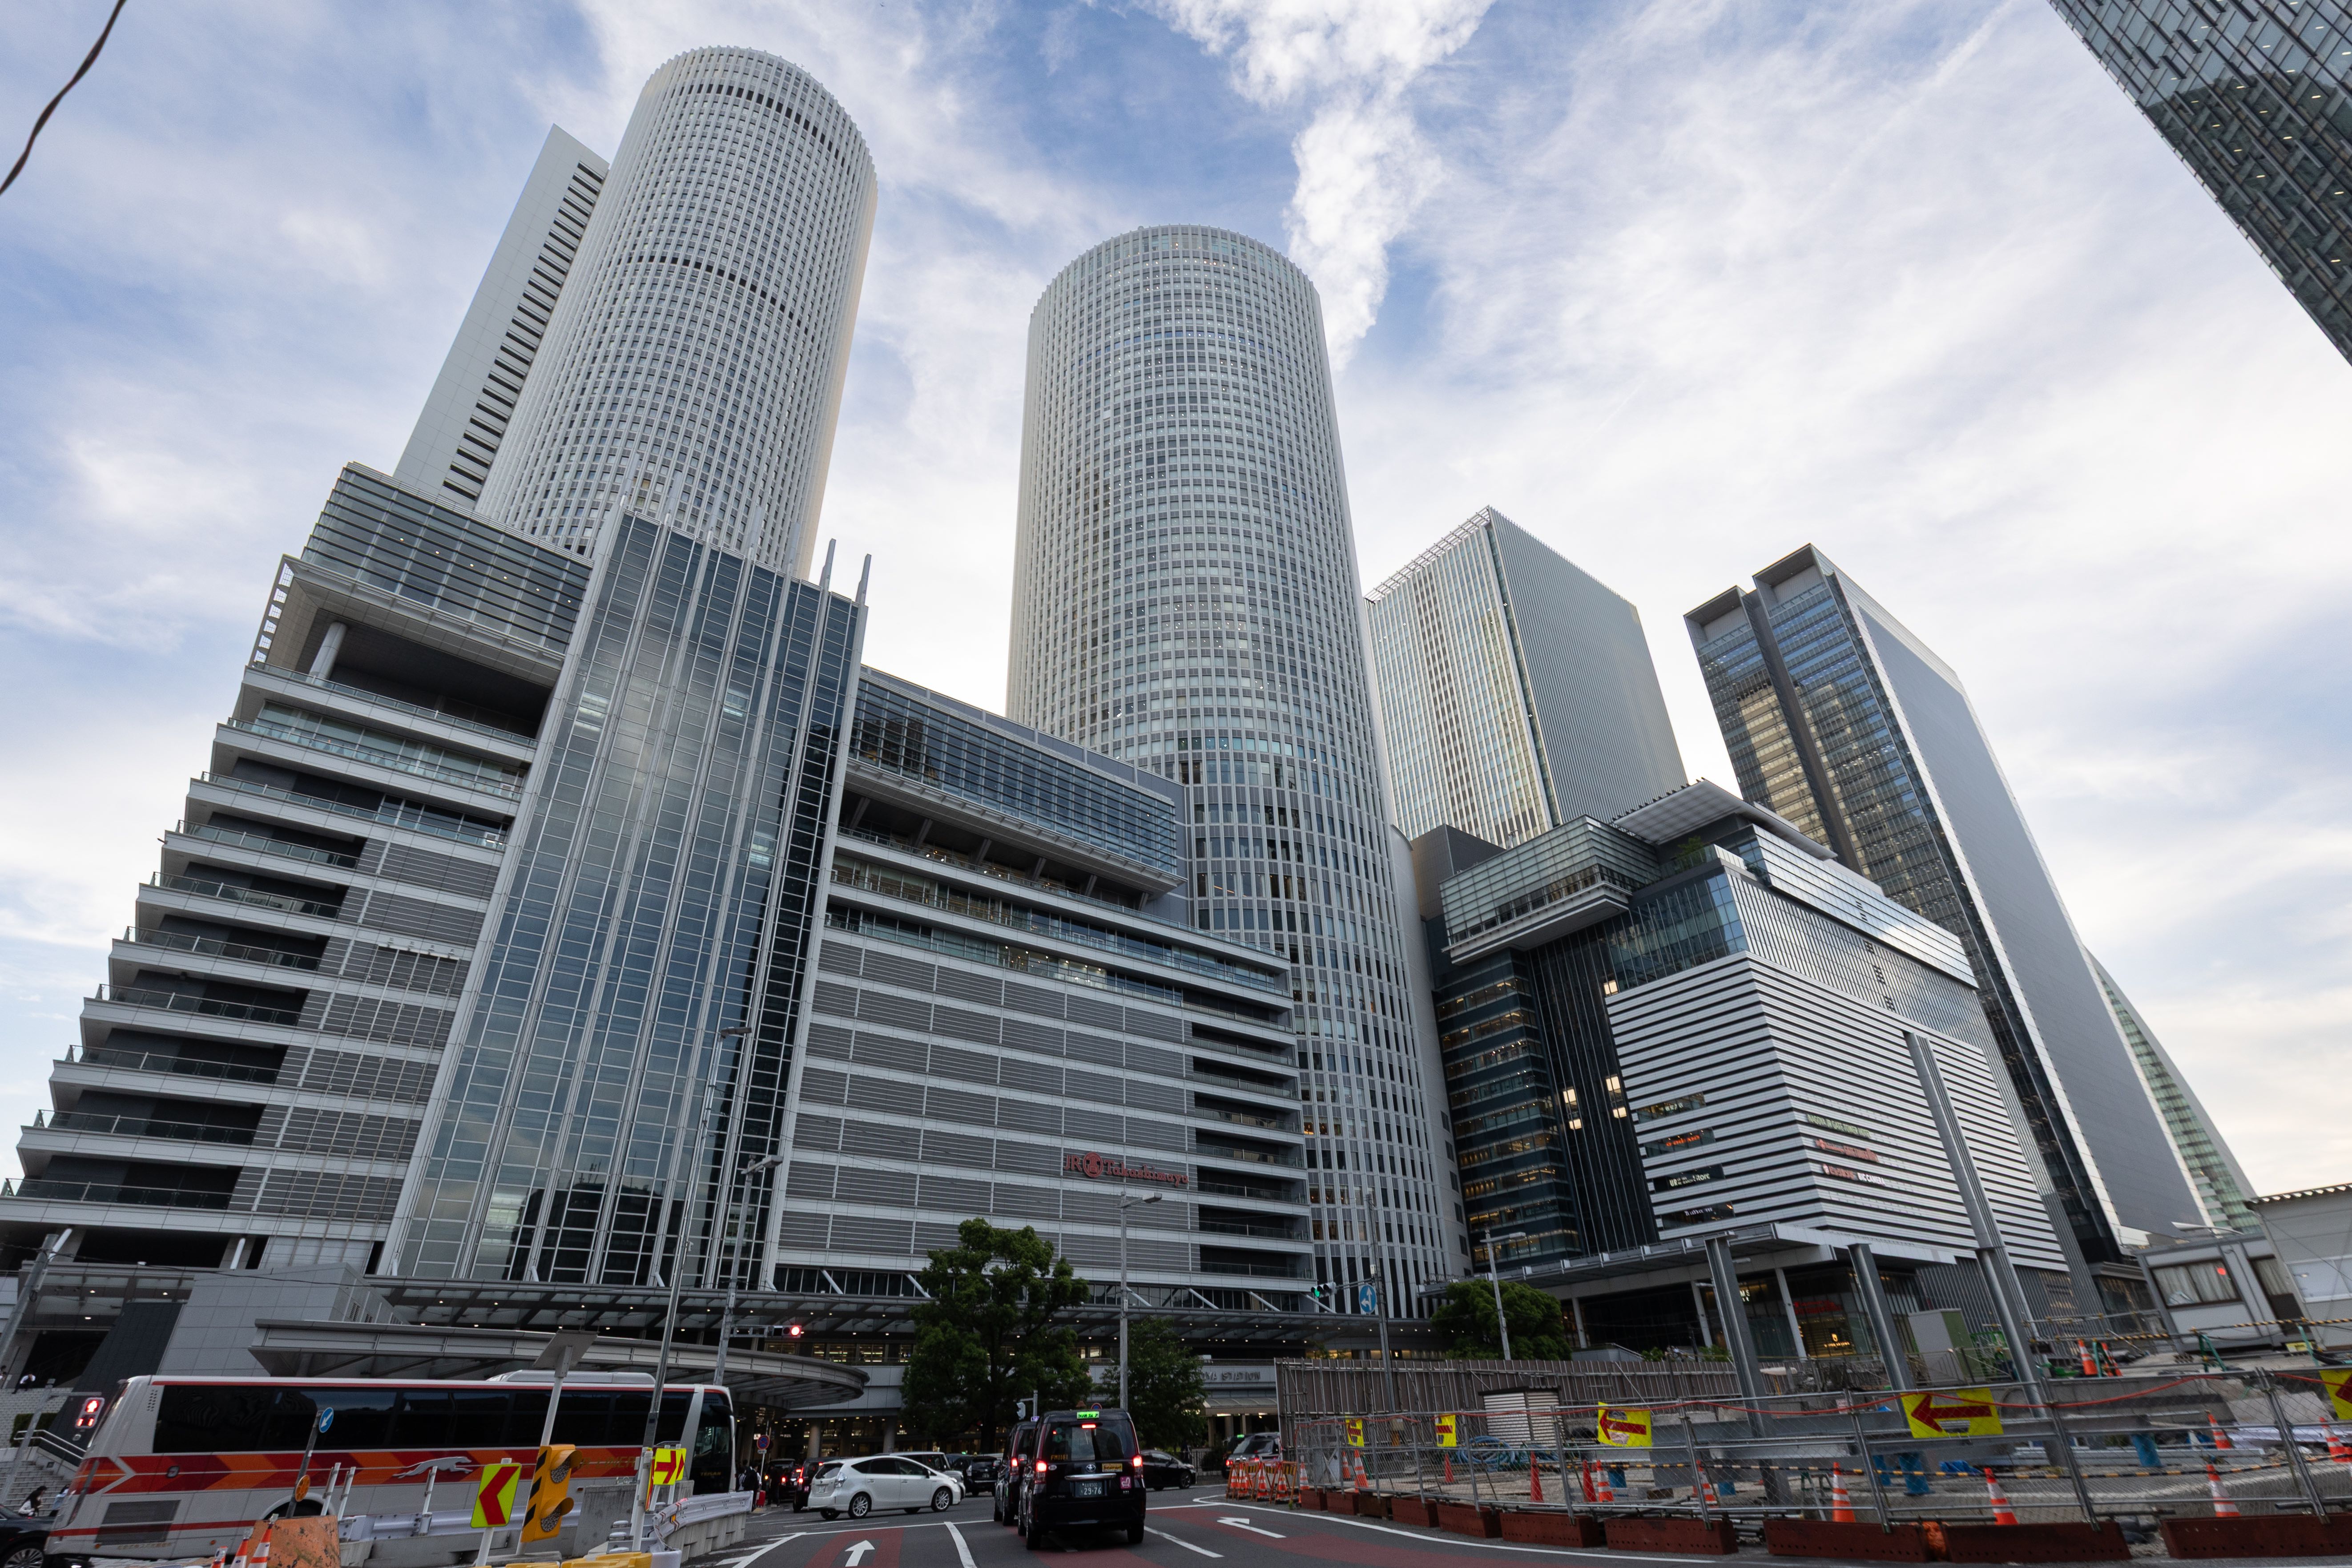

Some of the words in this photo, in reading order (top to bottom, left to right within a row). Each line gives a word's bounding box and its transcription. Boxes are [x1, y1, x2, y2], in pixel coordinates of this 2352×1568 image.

[1065, 1154, 1082, 1172] JR
[1104, 1159, 1189, 1187] Takashimaya
[1669, 1179, 1678, 1187] UR
[1222, 1372, 1261, 1381] STATION
